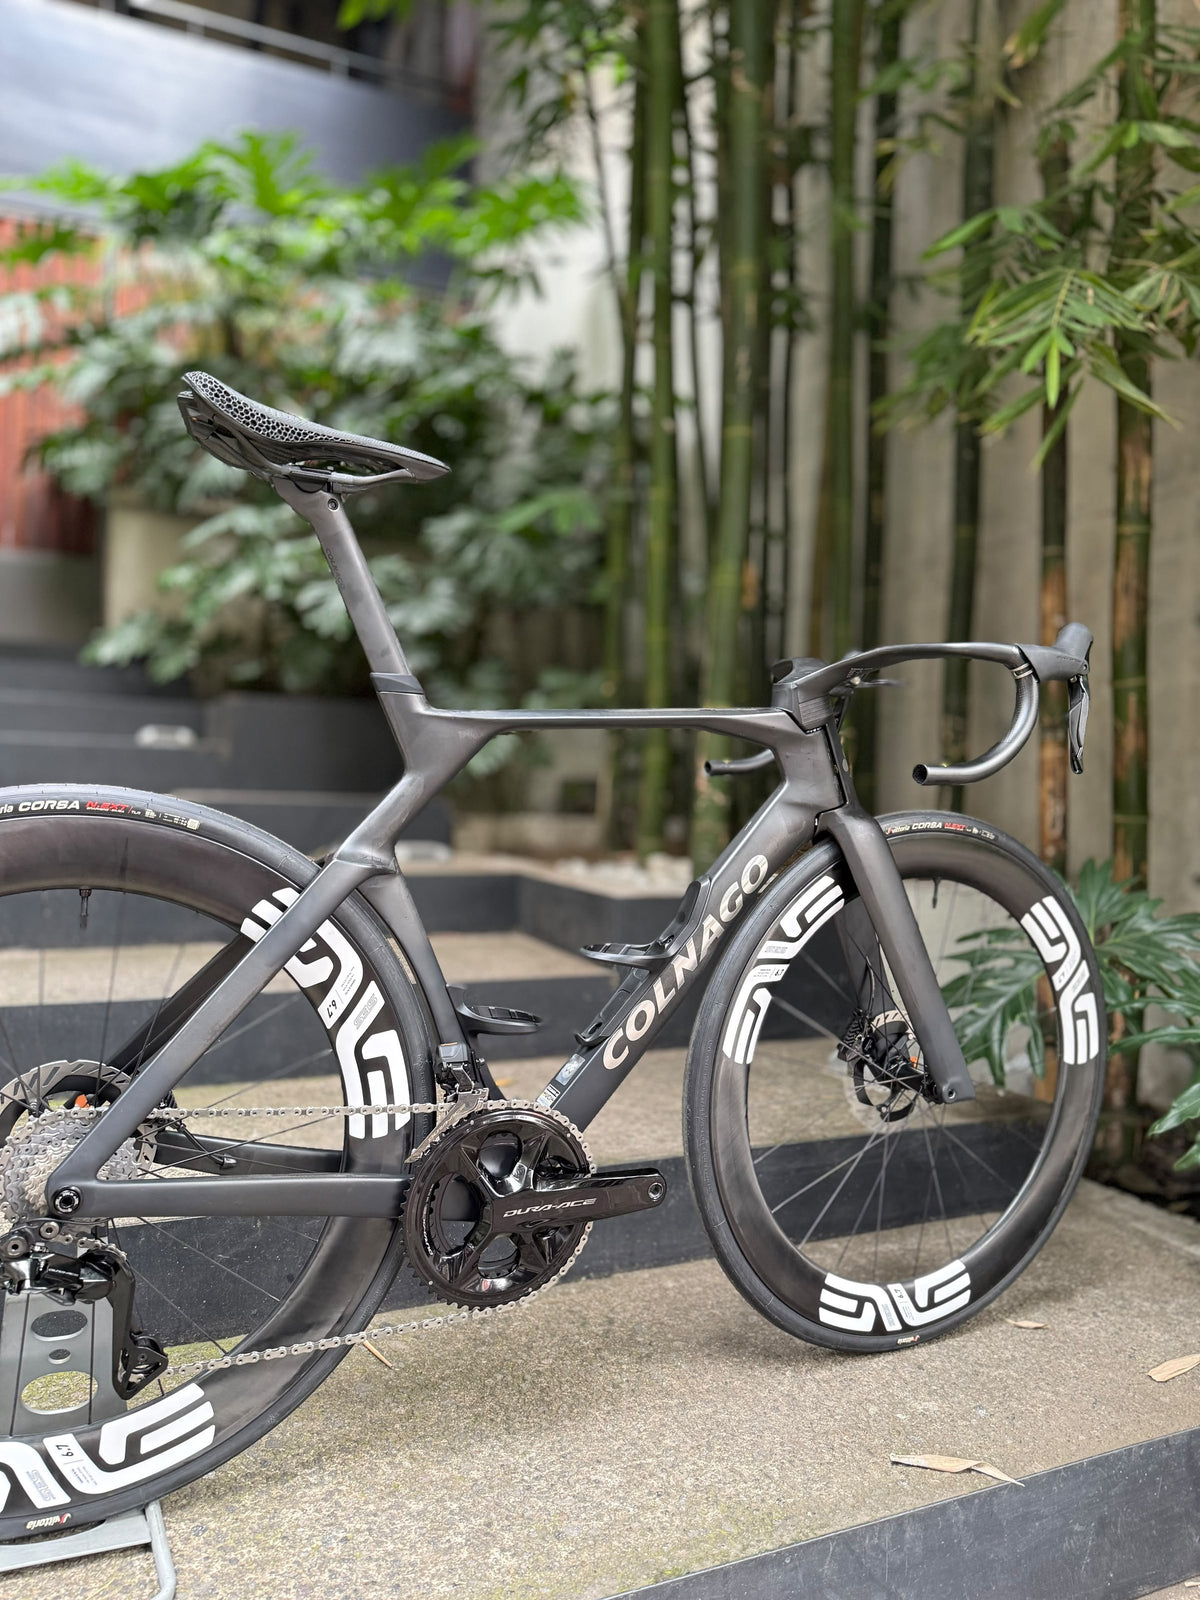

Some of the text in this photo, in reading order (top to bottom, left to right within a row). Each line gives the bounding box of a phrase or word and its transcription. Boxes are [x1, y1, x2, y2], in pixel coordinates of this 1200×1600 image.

[18, 800, 80, 812] CORSA
[911, 821, 943, 830] CORSA
[602, 854, 769, 1070] COLNAGO
[326, 1000, 337, 1018] 6.7
[503, 1198, 597, 1218] DURA-ACE
[55, 1445, 74, 1457] 6.7
[26, 1515, 61, 1530] vittoria
